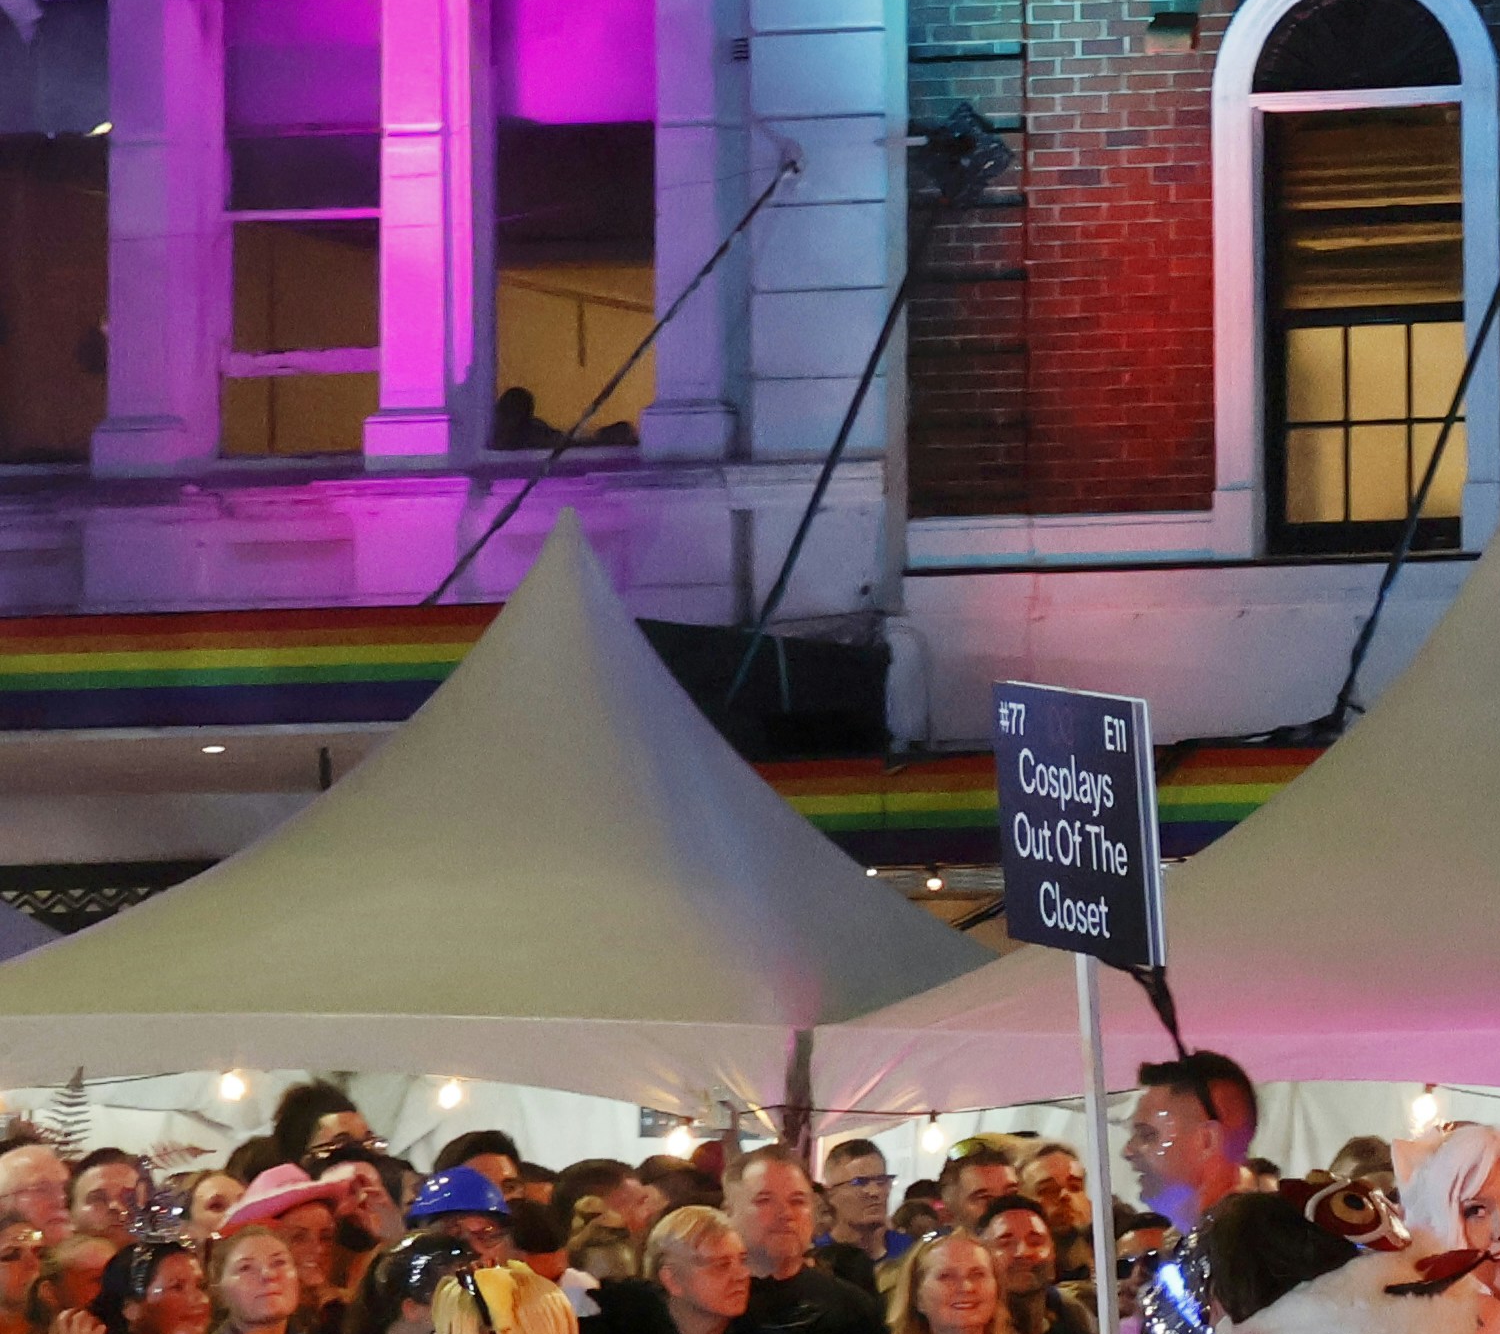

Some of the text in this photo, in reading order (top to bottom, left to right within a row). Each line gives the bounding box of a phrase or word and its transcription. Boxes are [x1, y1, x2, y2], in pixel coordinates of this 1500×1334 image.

[997, 700, 1127, 754] #77 E11
[1018, 747, 1115, 818] Cosplays
[1013, 811, 1129, 877] Out Of The
[1038, 880, 1111, 939] Closet
